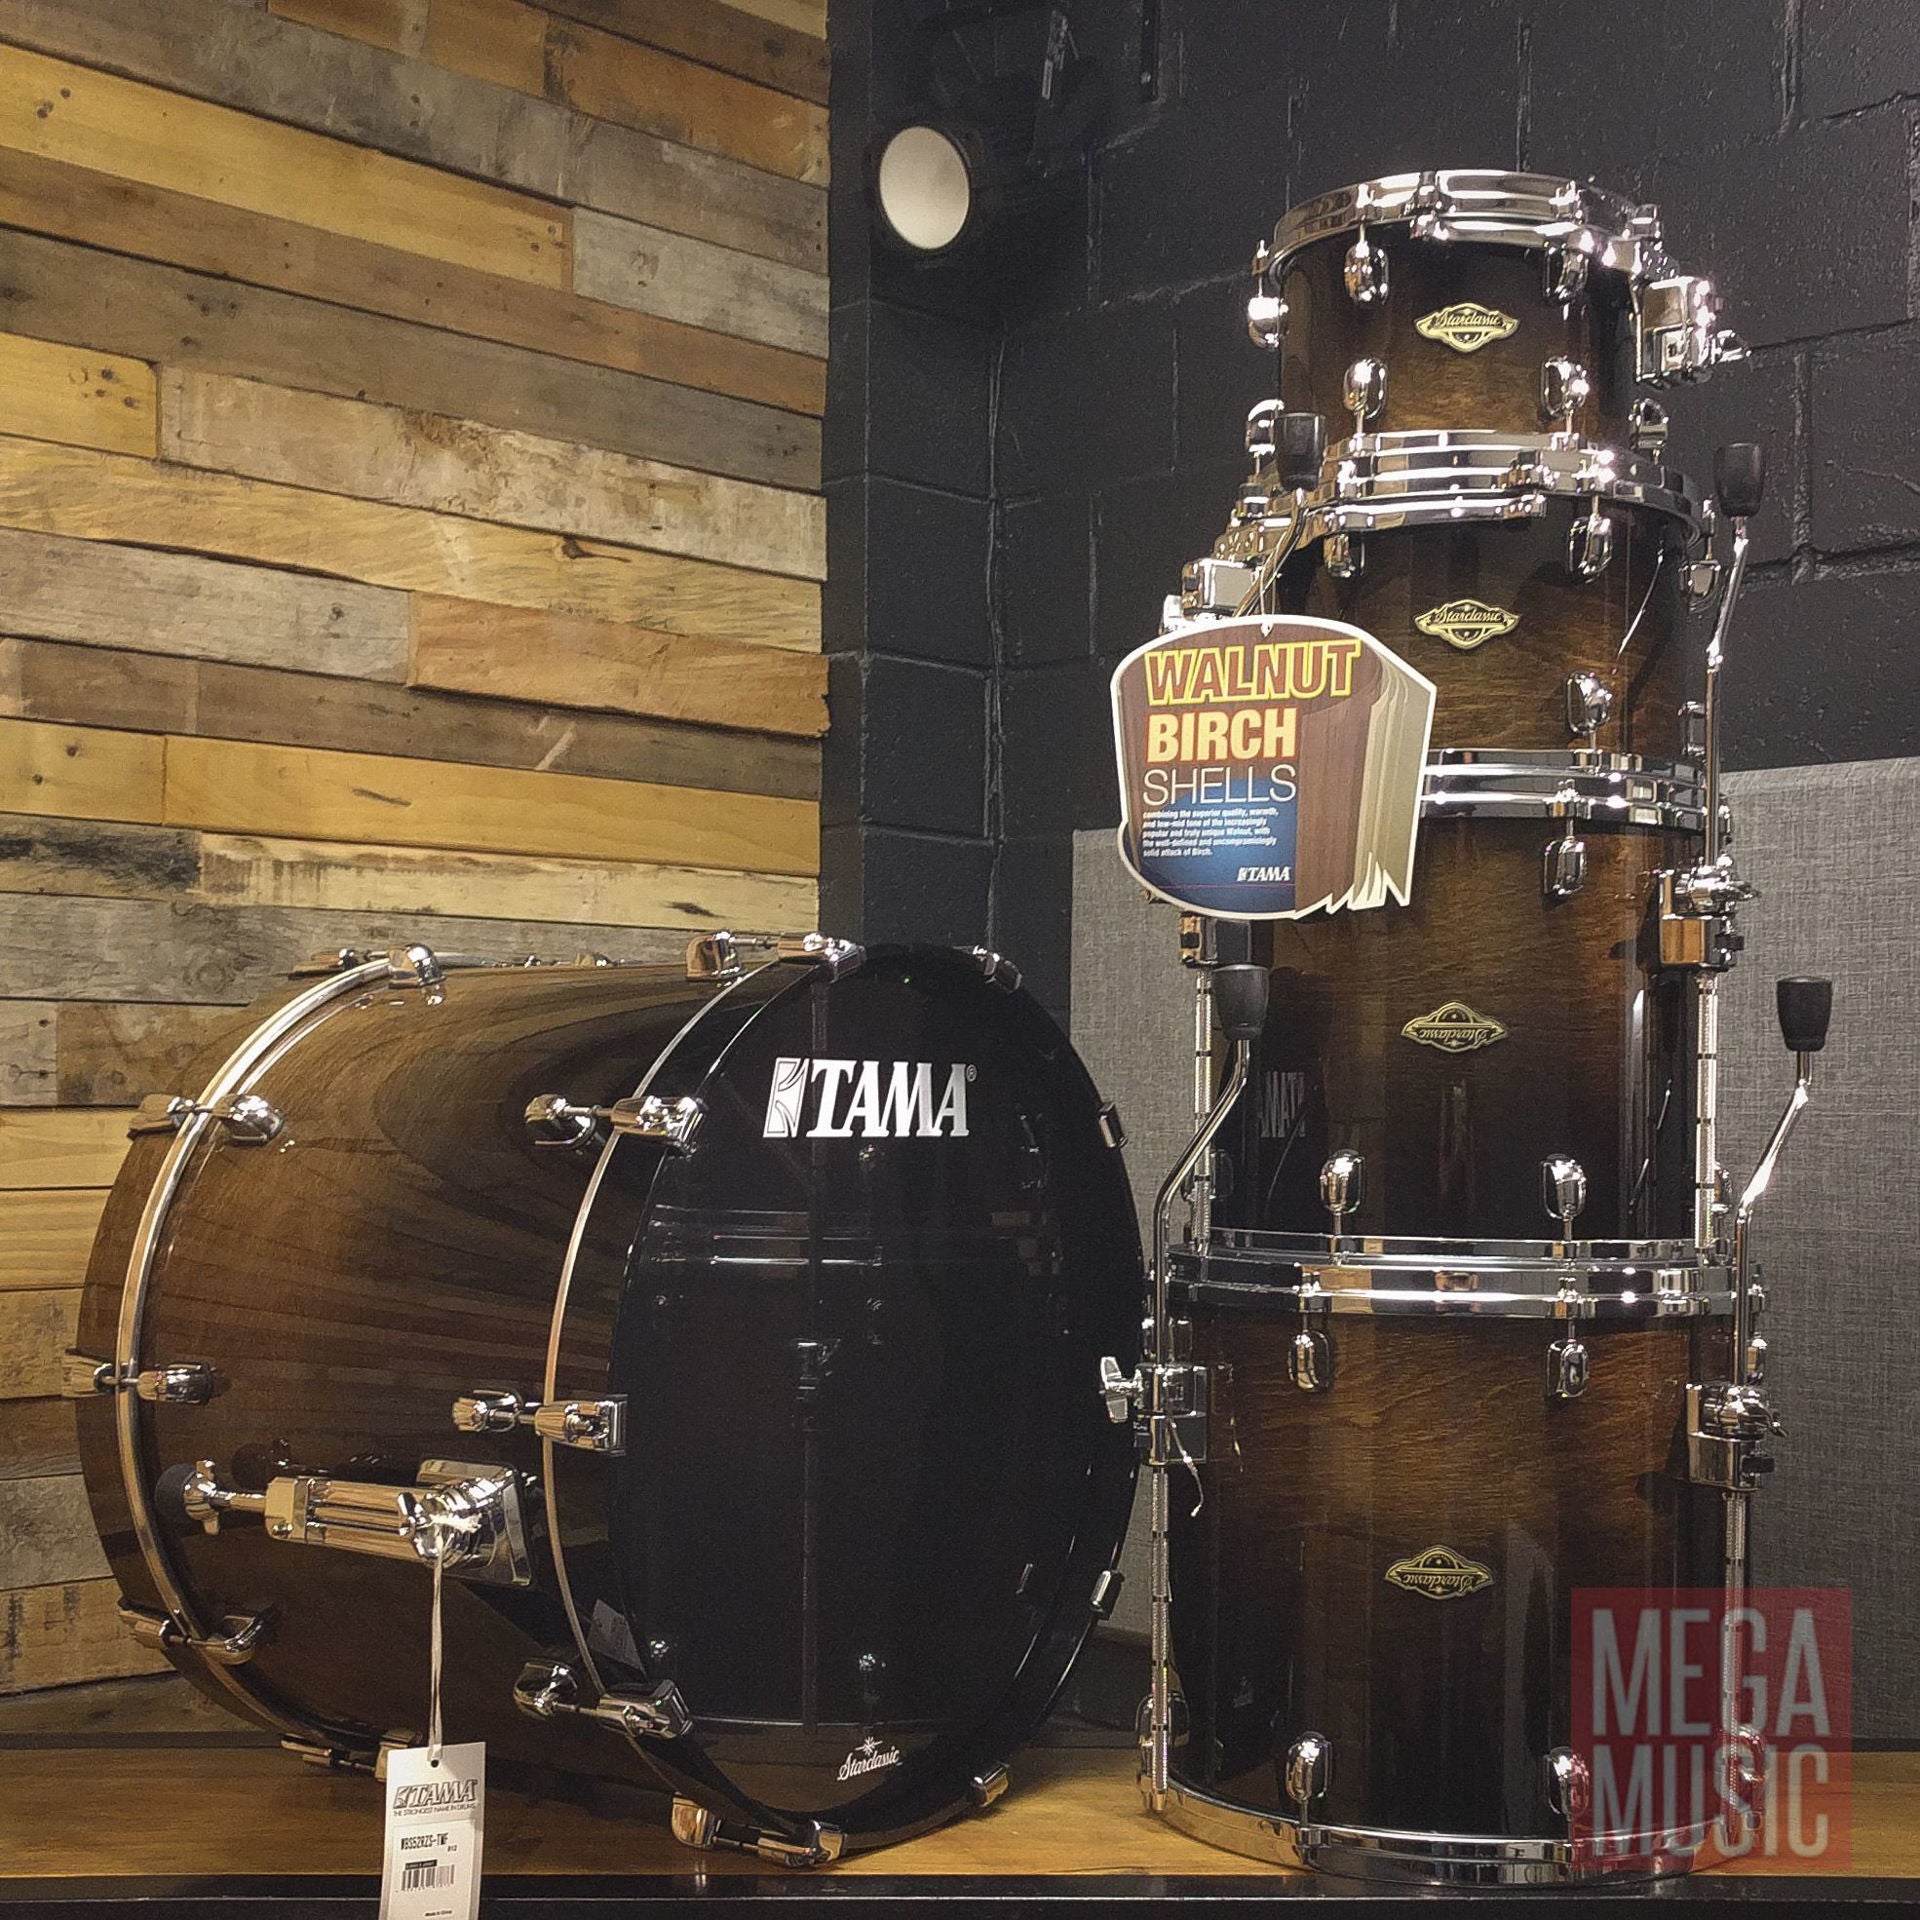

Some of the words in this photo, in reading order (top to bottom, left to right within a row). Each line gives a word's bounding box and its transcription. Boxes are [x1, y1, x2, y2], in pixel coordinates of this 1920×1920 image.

[1144, 639, 1361, 706] WALNUT
[1147, 707, 1297, 763] BIRCH
[1143, 764, 1296, 806] SHELLS
[1247, 866, 1292, 882] TAMA
[806, 1059, 970, 1137] TAMA
[837, 1746, 903, 1781] Starclassic
[408, 1779, 478, 1808] TAMA
